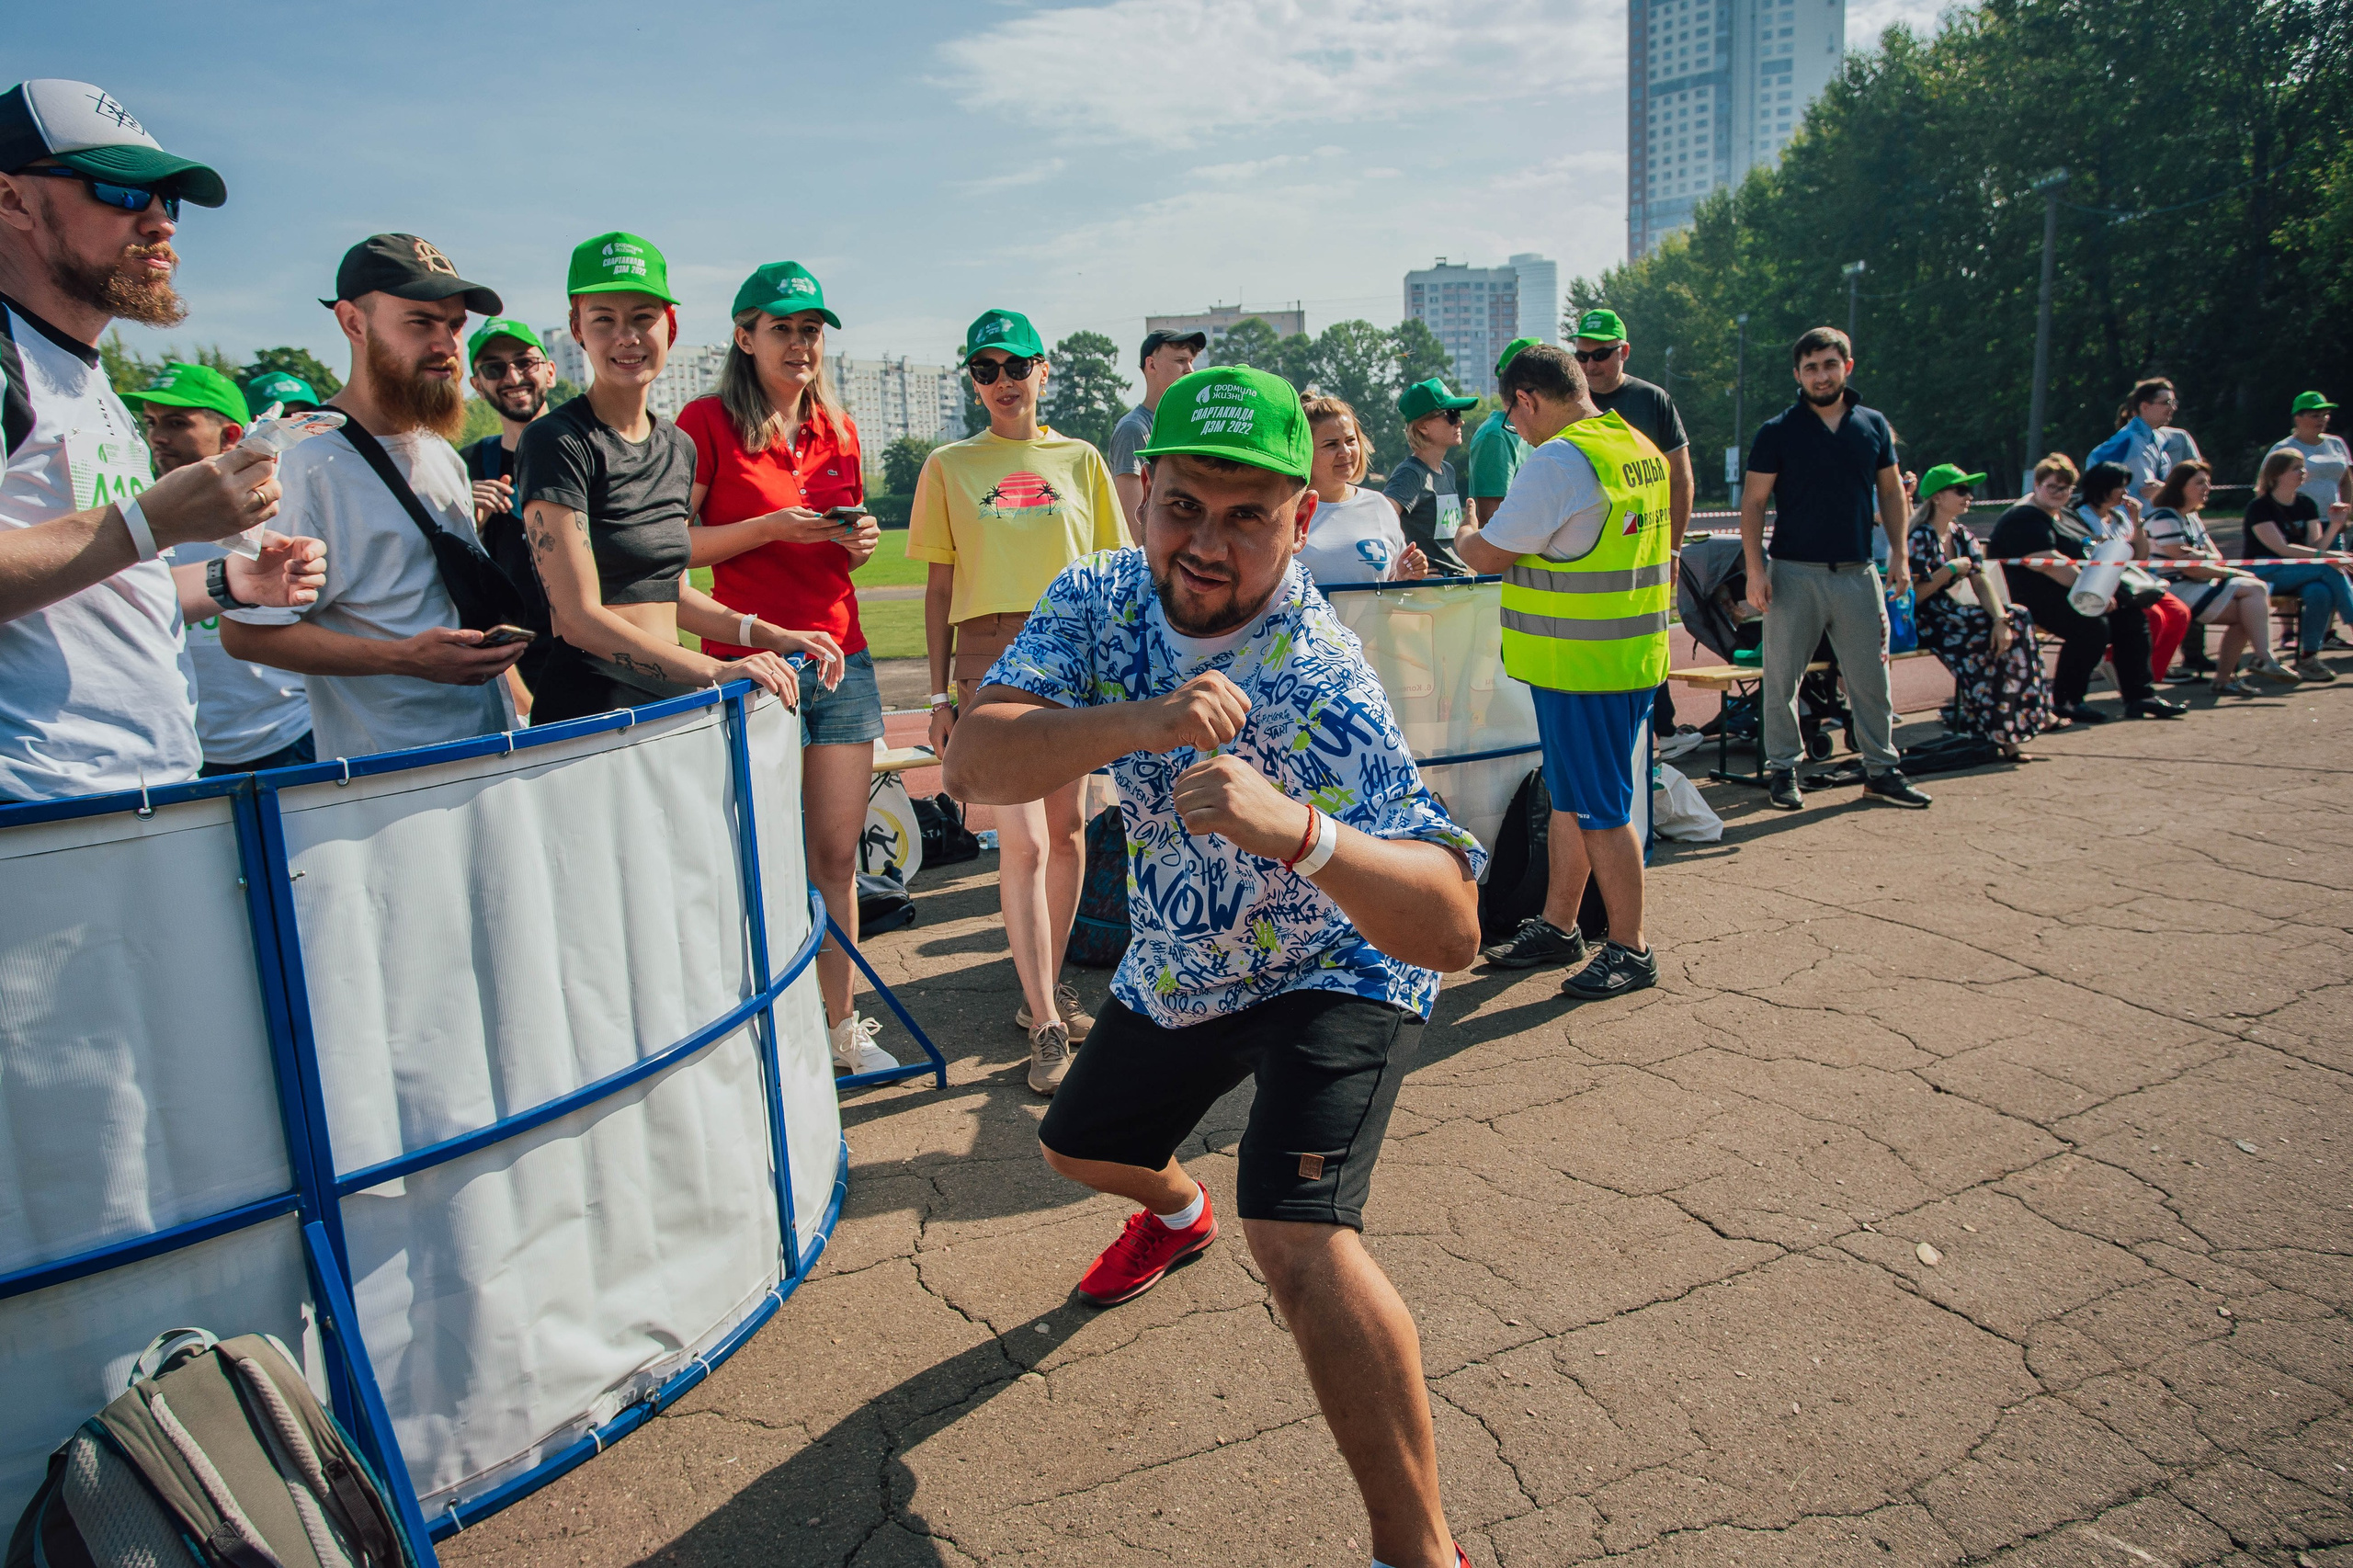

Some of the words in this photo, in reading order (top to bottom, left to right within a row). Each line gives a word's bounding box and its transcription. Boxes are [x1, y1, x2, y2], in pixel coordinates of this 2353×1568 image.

[603, 256, 645, 267] СПАРТАКИАДА
[613, 266, 630, 275] ДЗМ
[631, 266, 646, 277] 2022
[1212, 392, 1244, 402] жизни
[1213, 384, 1257, 397] формула
[1190, 406, 1255, 422] СПАРТАКИАДА
[1199, 420, 1227, 436] ДЗМ
[1226, 420, 1254, 435] 2022
[1622, 457, 1665, 488] СУДЬЯ
[1441, 507, 1460, 528] 418
